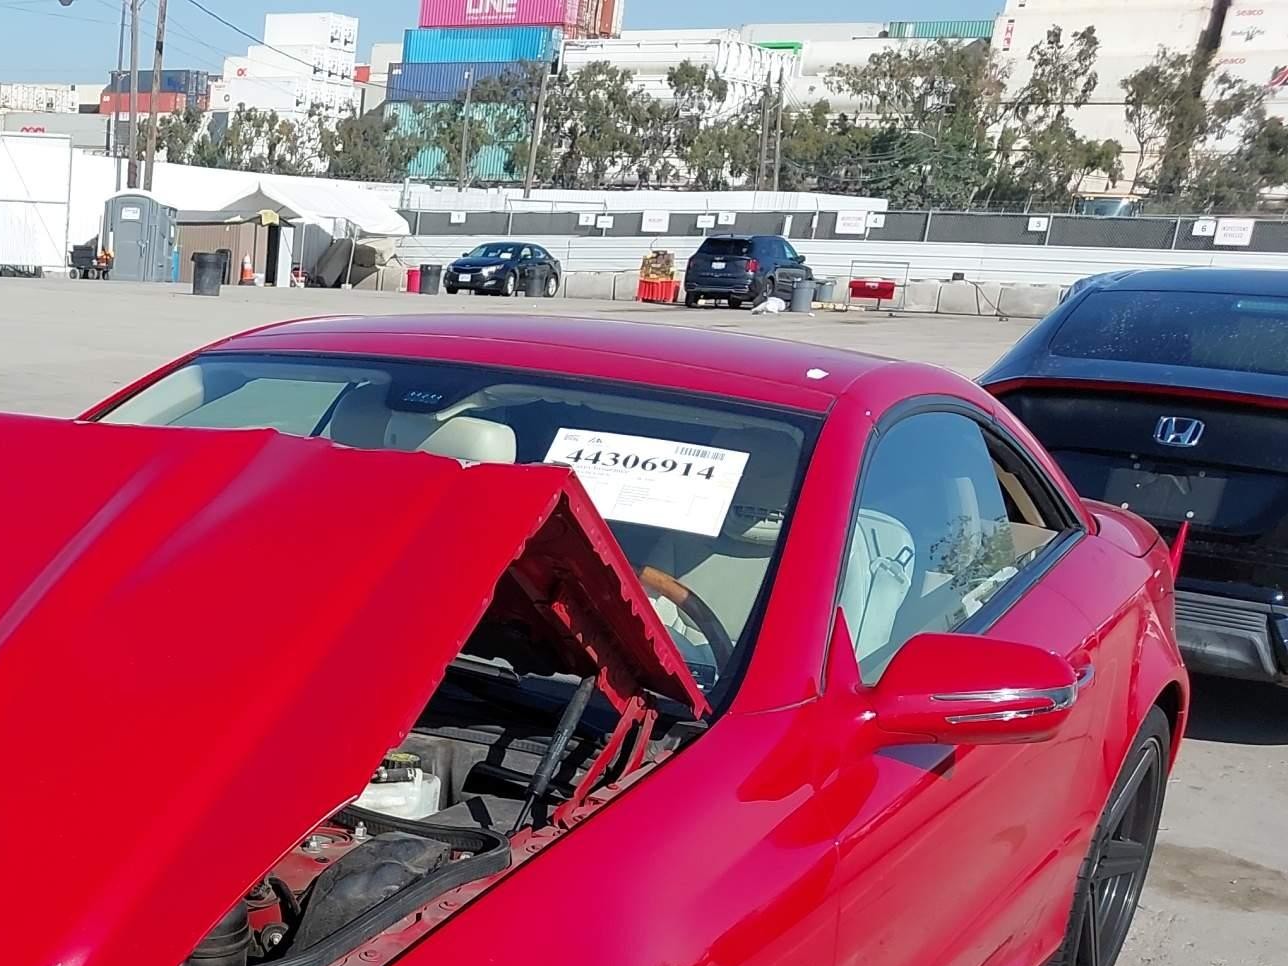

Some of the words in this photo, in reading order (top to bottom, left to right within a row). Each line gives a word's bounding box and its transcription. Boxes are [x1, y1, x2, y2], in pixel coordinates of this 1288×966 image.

[1235, 9, 1264, 17] seaco
[1035, 220, 1041, 228] 5
[1201, 224, 1208, 233] 6
[566, 448, 716, 480] 44306914
